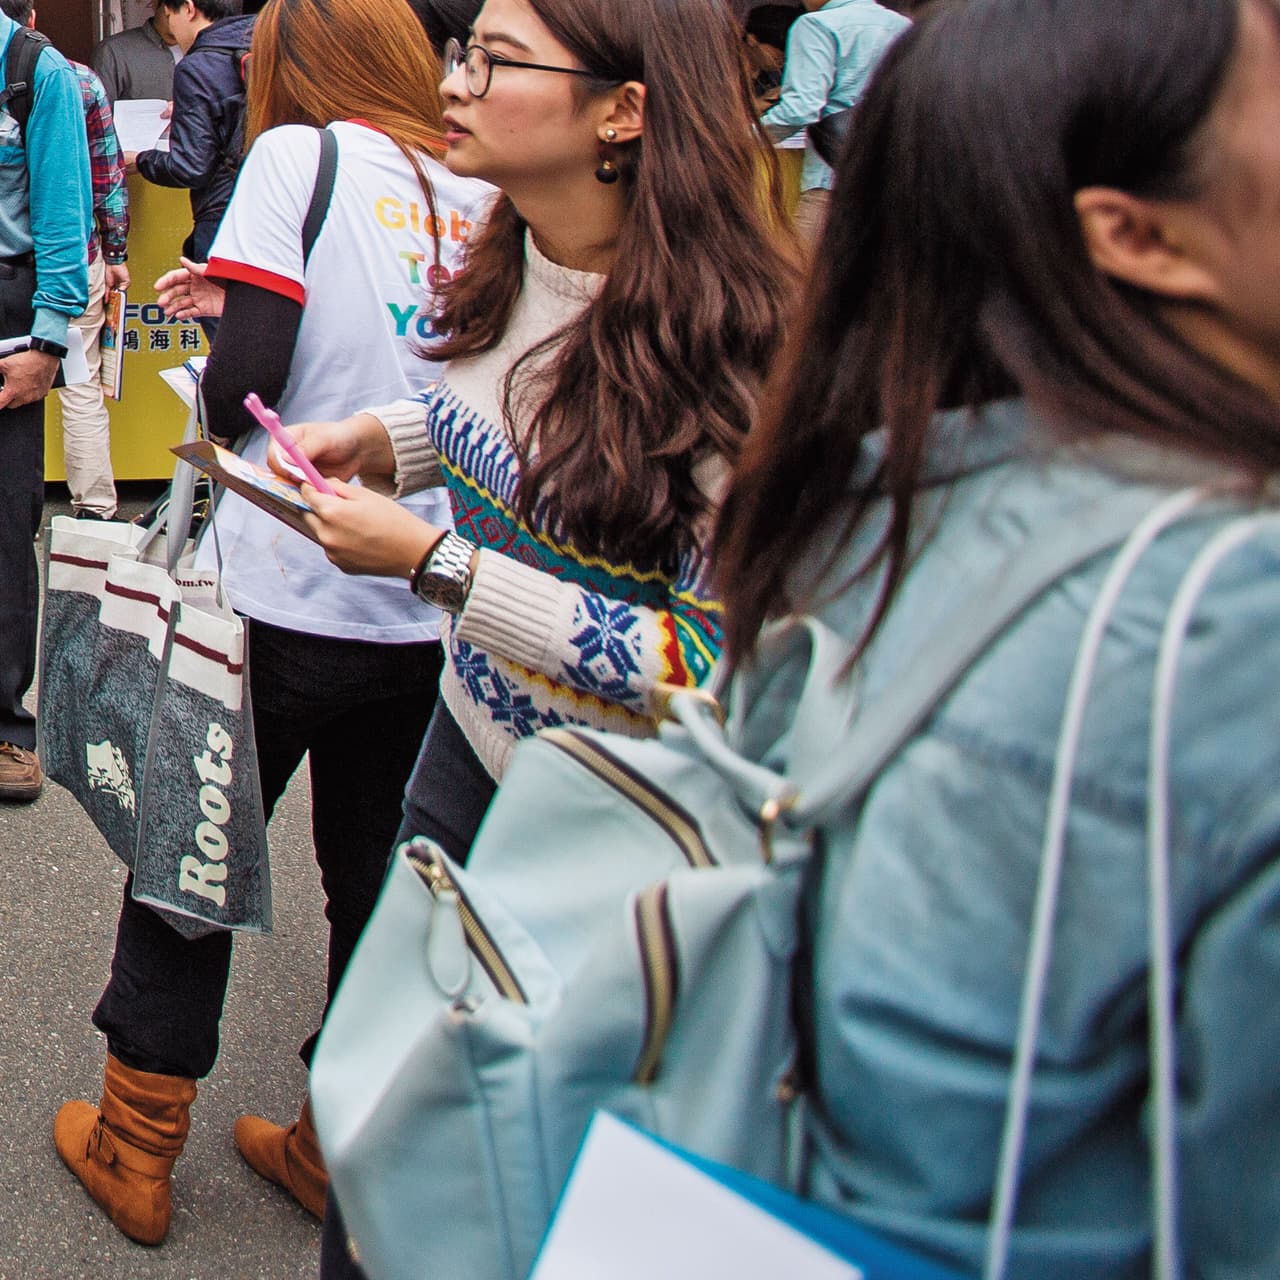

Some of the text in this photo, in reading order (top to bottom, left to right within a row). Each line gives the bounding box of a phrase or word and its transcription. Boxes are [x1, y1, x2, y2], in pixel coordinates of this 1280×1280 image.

[374, 196, 472, 243] Glob
[126, 304, 199, 325] FO
[386, 302, 450, 339] Yo
[175, 578, 216, 588] om.tw
[178, 722, 234, 908] Roots
